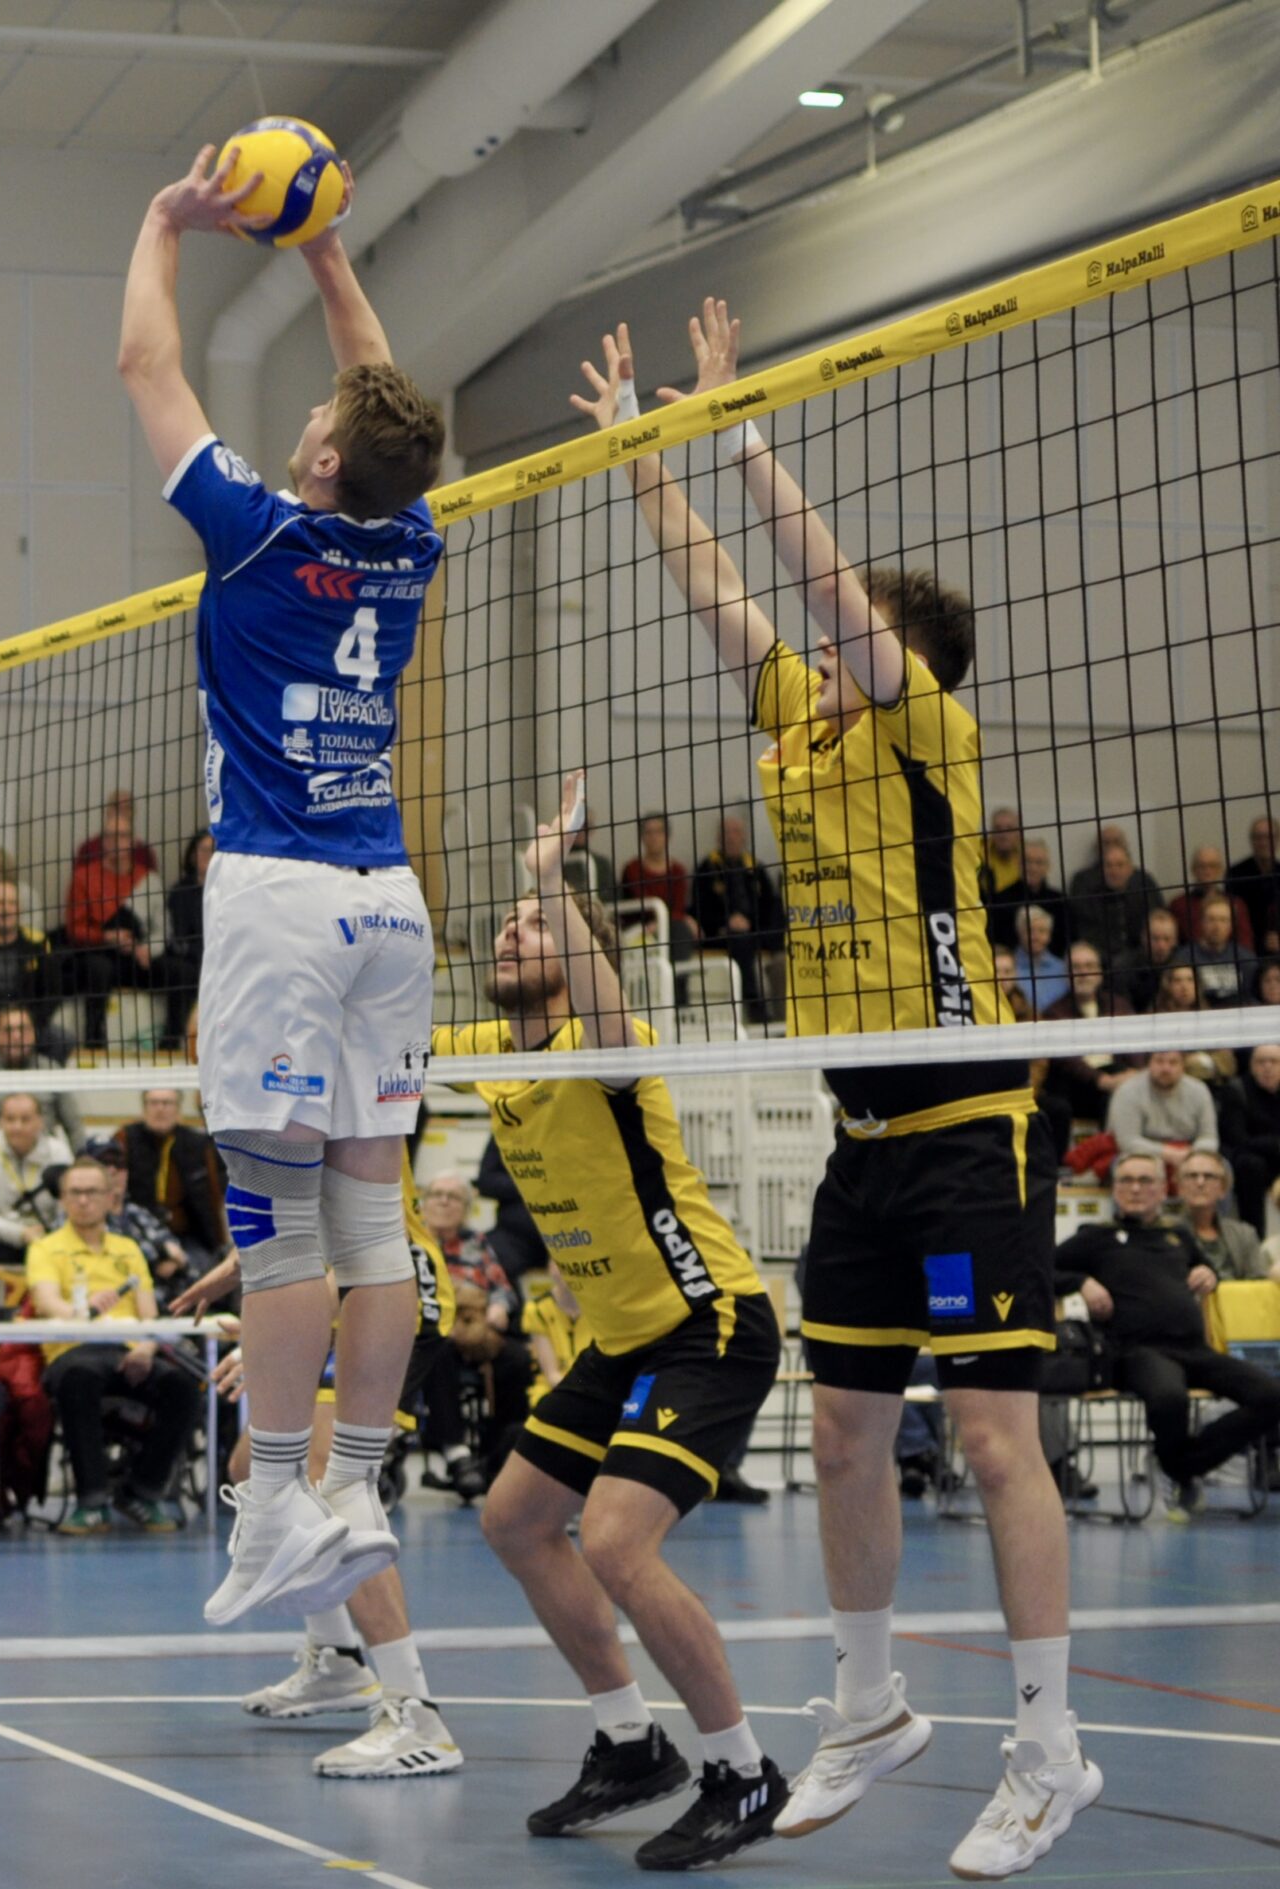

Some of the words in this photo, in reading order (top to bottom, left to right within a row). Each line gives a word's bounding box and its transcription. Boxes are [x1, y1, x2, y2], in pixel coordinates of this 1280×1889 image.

[1106, 242, 1165, 277] HalpaHalli
[964, 296, 1018, 328] HalpaHalli
[334, 606, 380, 692] 4
[318, 734, 376, 751] TOIJALAN
[643, 1208, 717, 1298] SKPO
